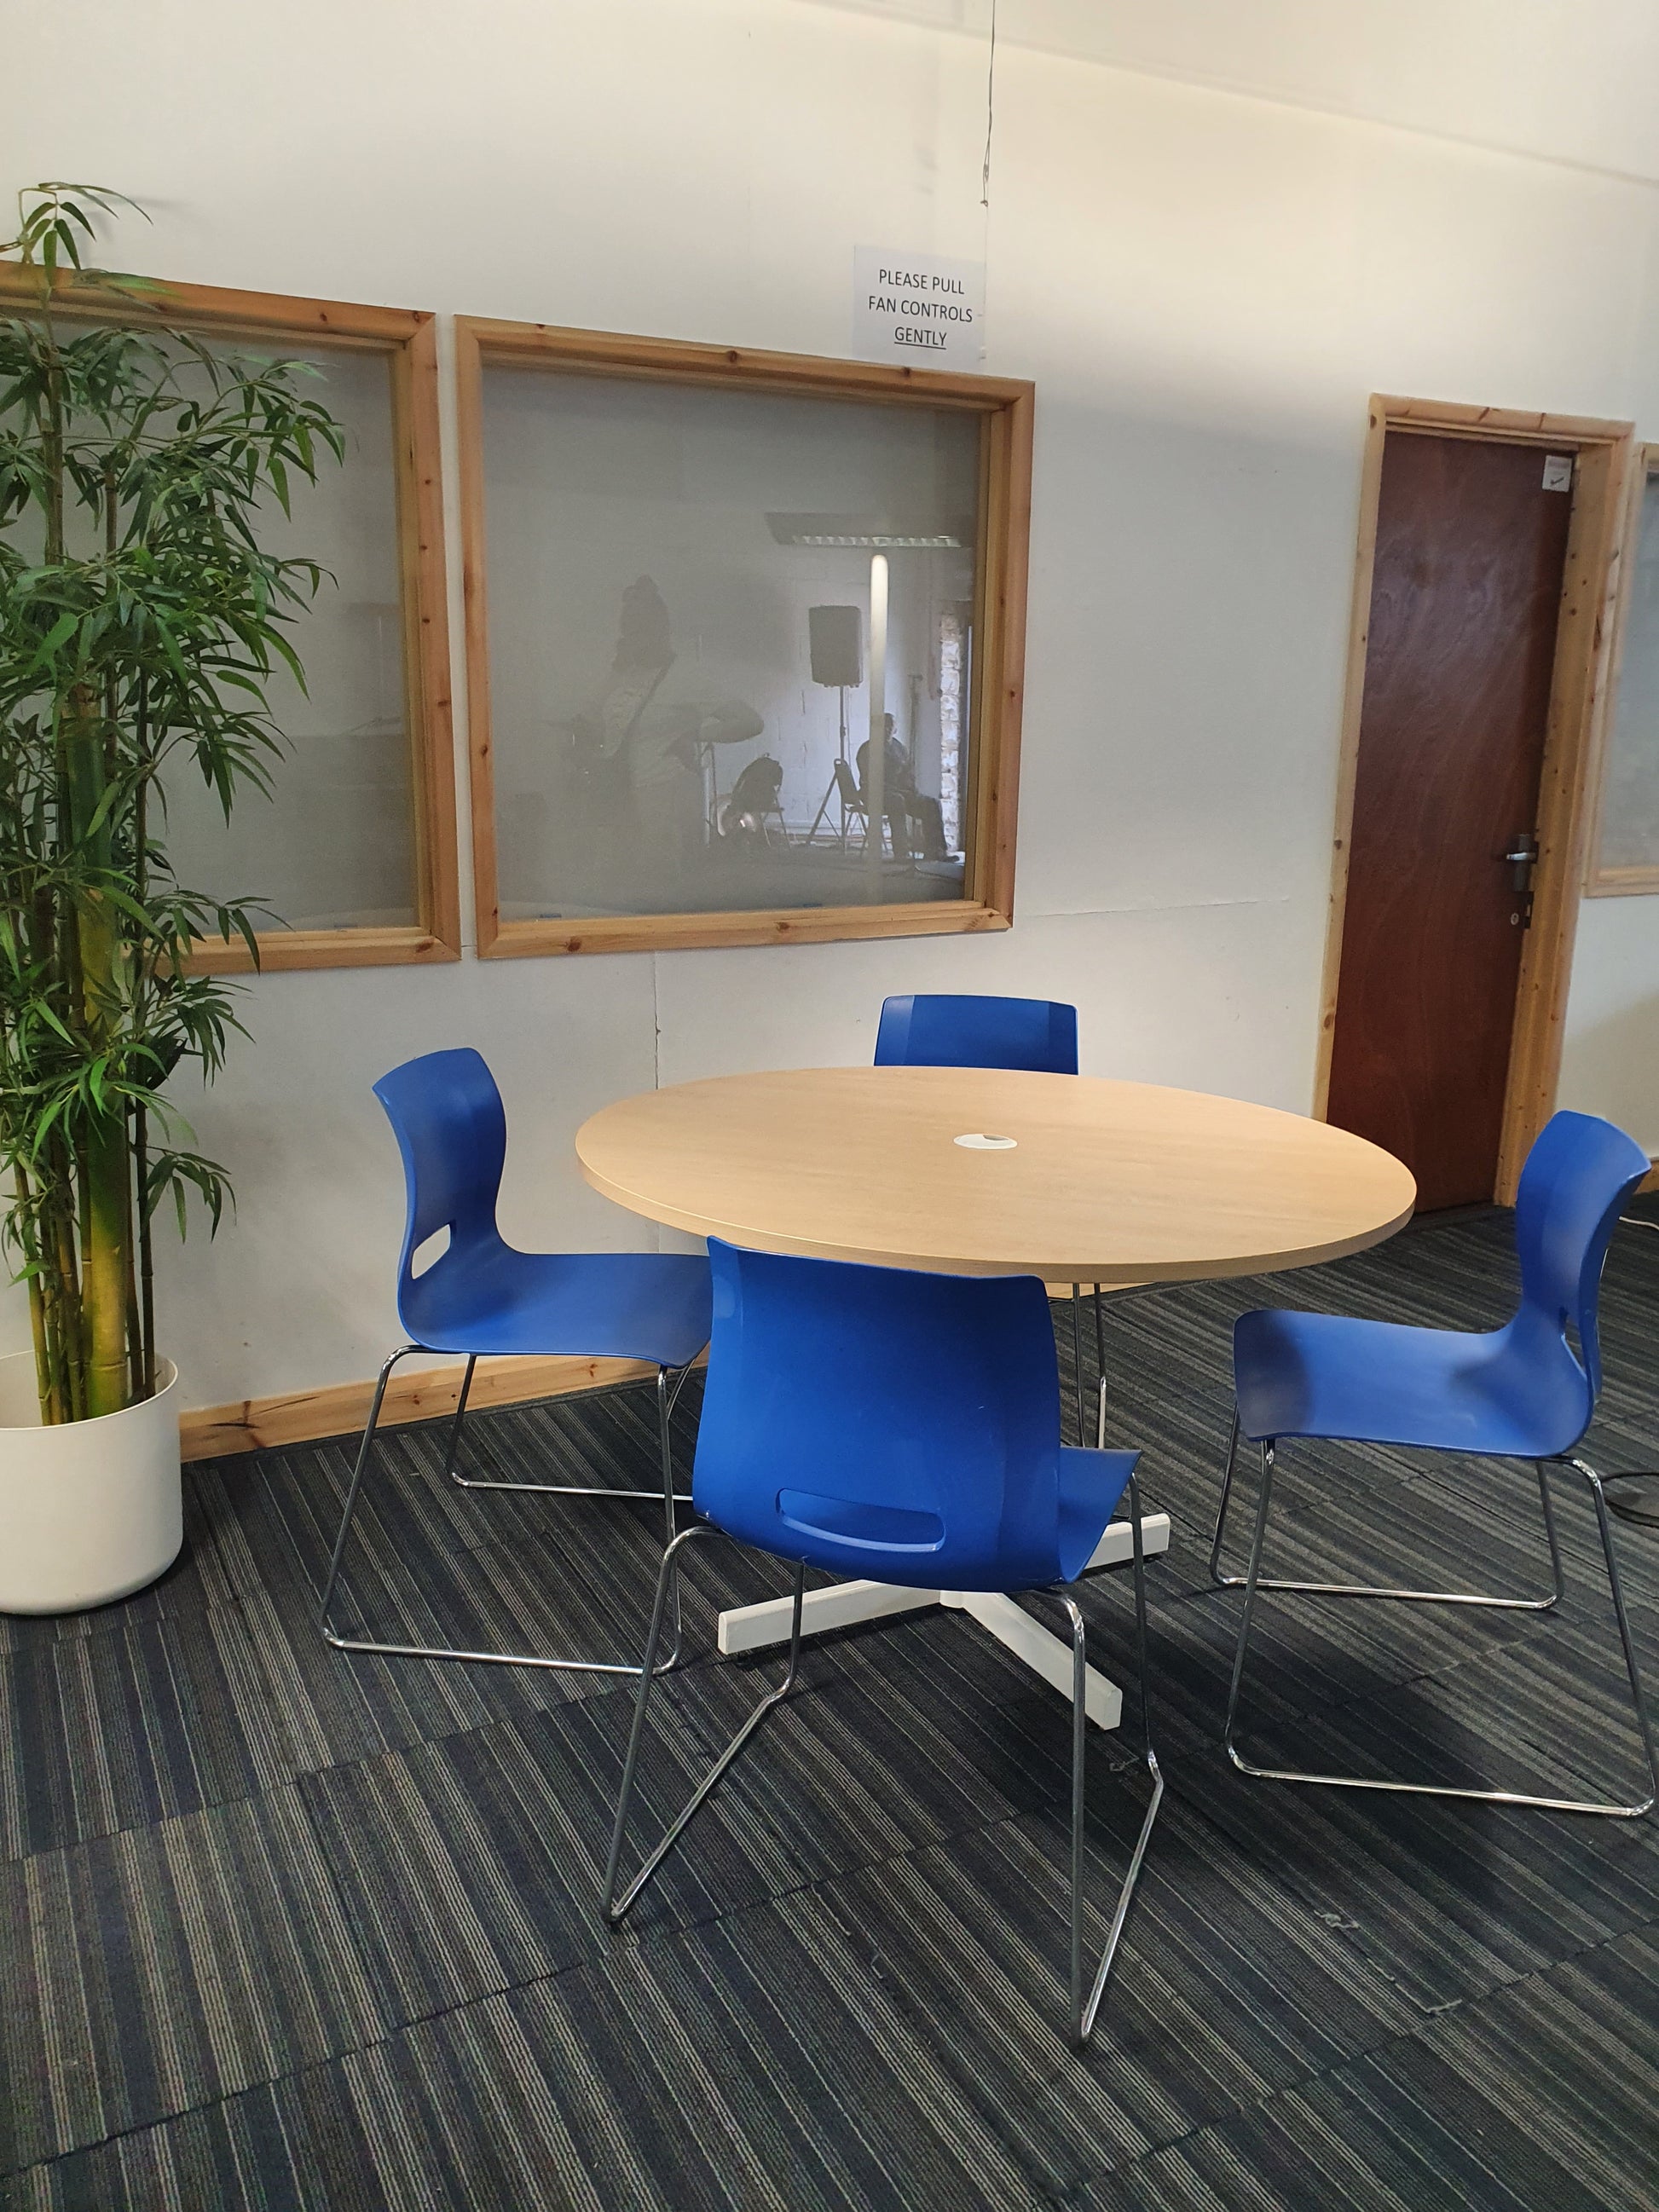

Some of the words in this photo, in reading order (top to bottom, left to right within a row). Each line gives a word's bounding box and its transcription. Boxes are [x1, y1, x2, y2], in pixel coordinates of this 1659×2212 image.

[879, 269, 928, 290] PLEASE
[933, 276, 965, 295] PULL
[869, 295, 897, 313] FAN
[901, 299, 973, 322] CONTROLS
[894, 326, 947, 347] GENTLY
